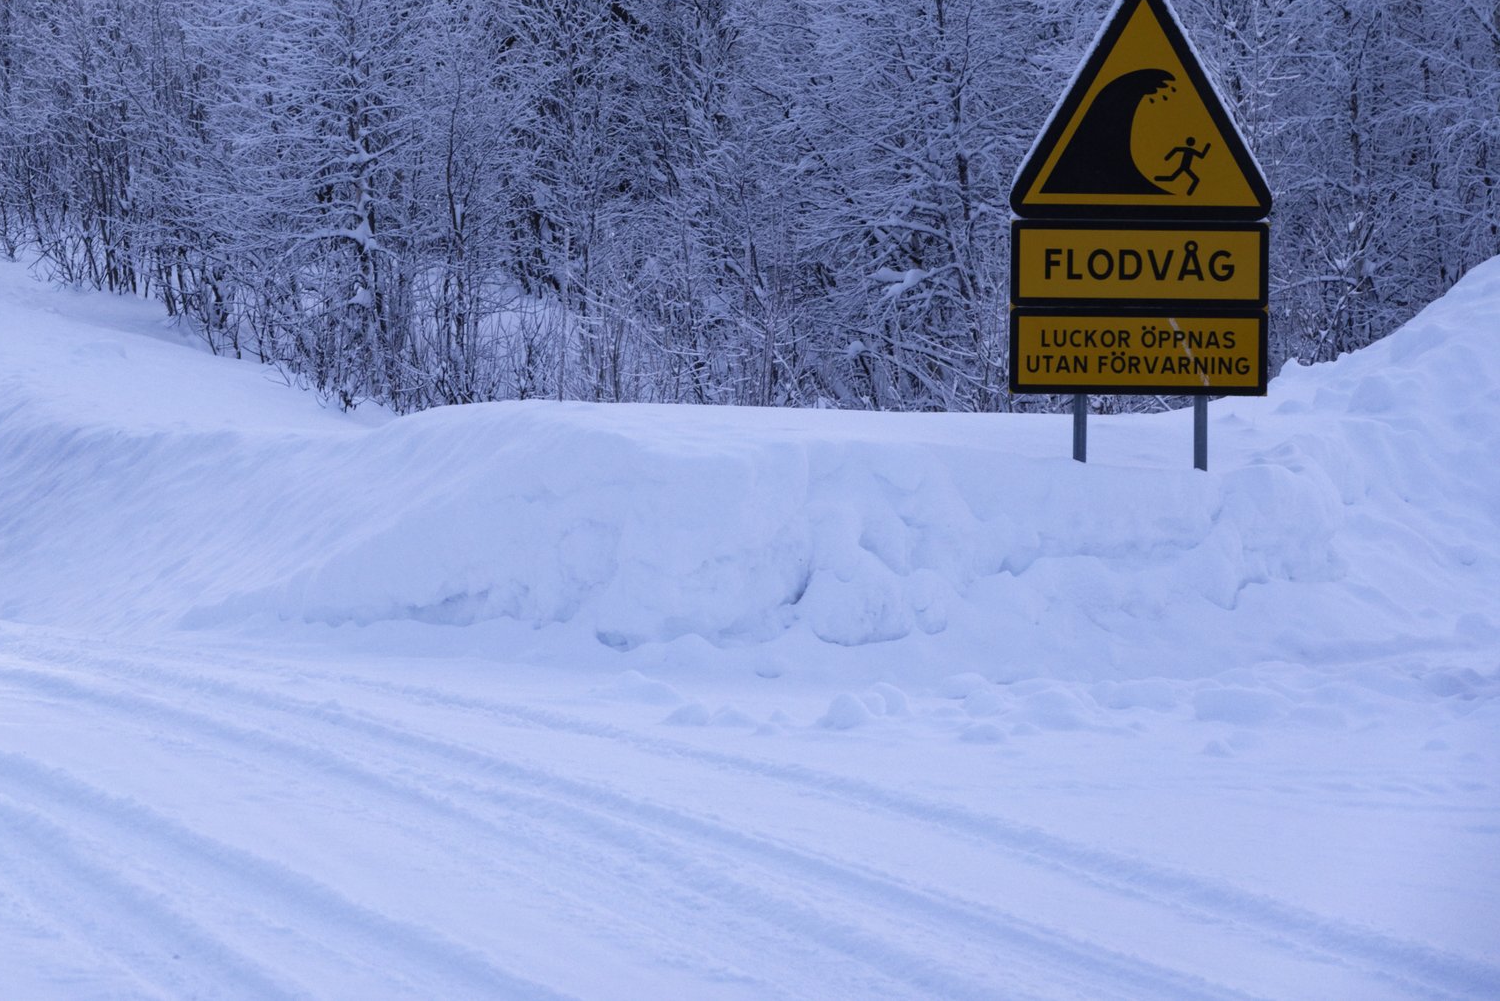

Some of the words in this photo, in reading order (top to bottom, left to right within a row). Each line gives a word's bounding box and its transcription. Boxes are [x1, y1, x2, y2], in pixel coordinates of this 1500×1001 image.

[1044, 240, 1235, 281] FLODVÅG
[1041, 329, 1131, 348] LUCKOR
[1141, 325, 1236, 349] ÖPPNAS
[1026, 354, 1089, 374] UTAN
[1098, 351, 1251, 376] FÖRVARNING
